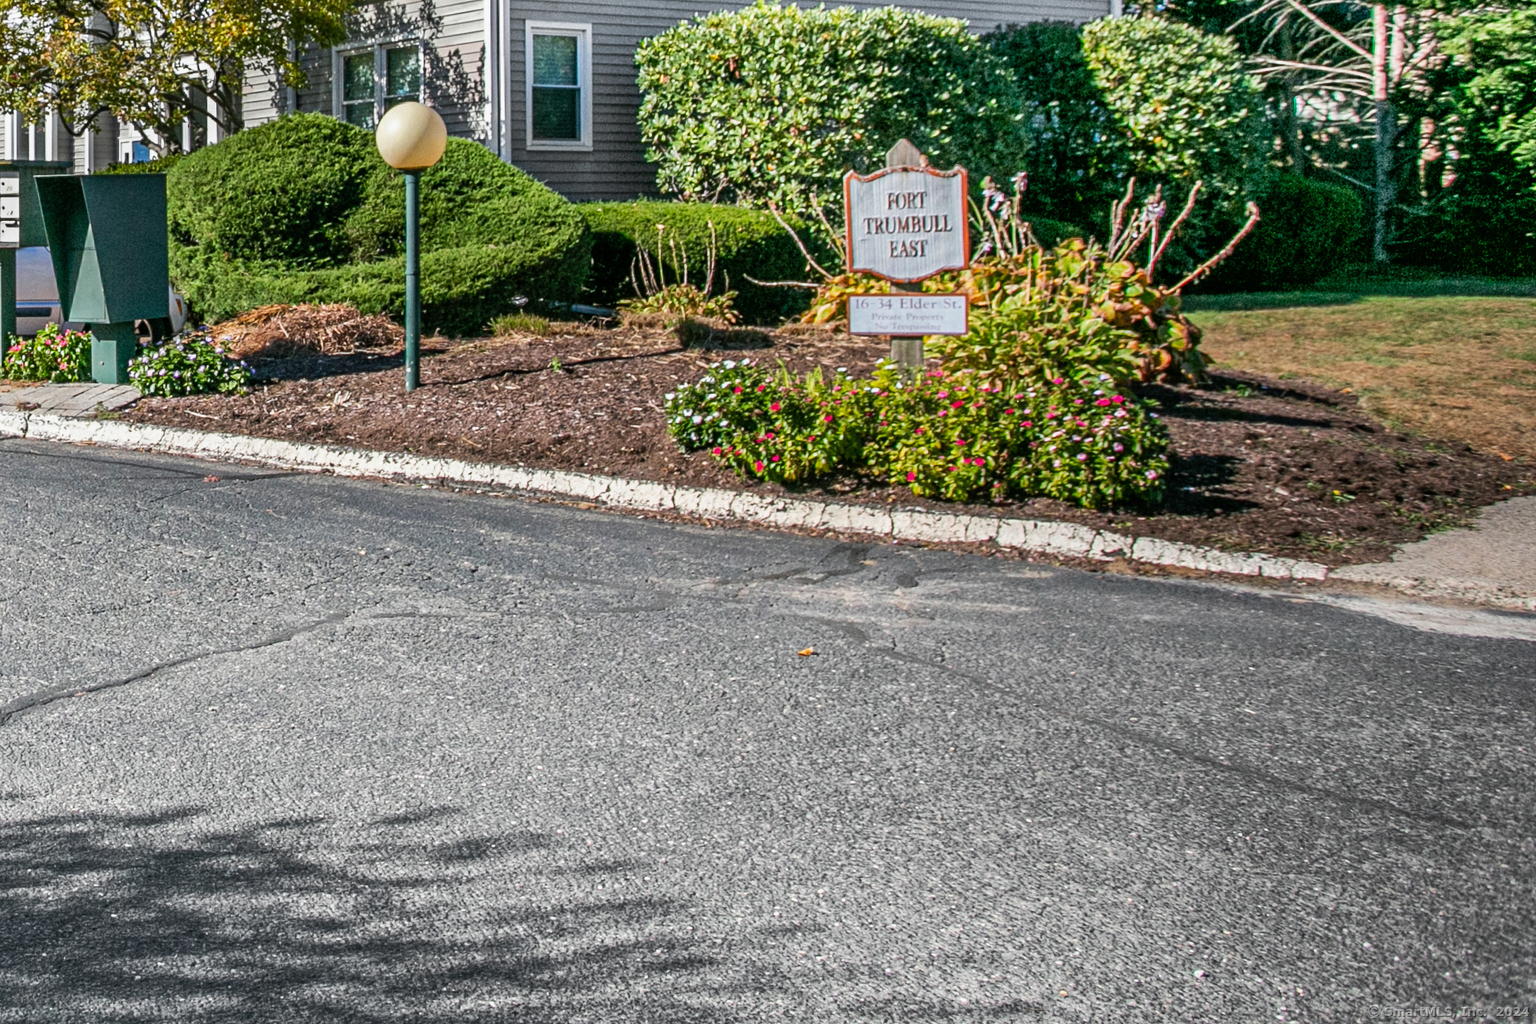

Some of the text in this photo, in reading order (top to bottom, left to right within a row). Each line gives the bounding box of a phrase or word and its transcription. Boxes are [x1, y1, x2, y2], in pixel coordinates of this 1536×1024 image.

[887, 191, 928, 210] FORT
[863, 214, 953, 235] TRUMBULL
[889, 240, 928, 258] EAST
[854, 297, 962, 310] 16-34 Elder St.
[871, 313, 944, 322] Private Property
[875, 322, 942, 331] No Trespassing
